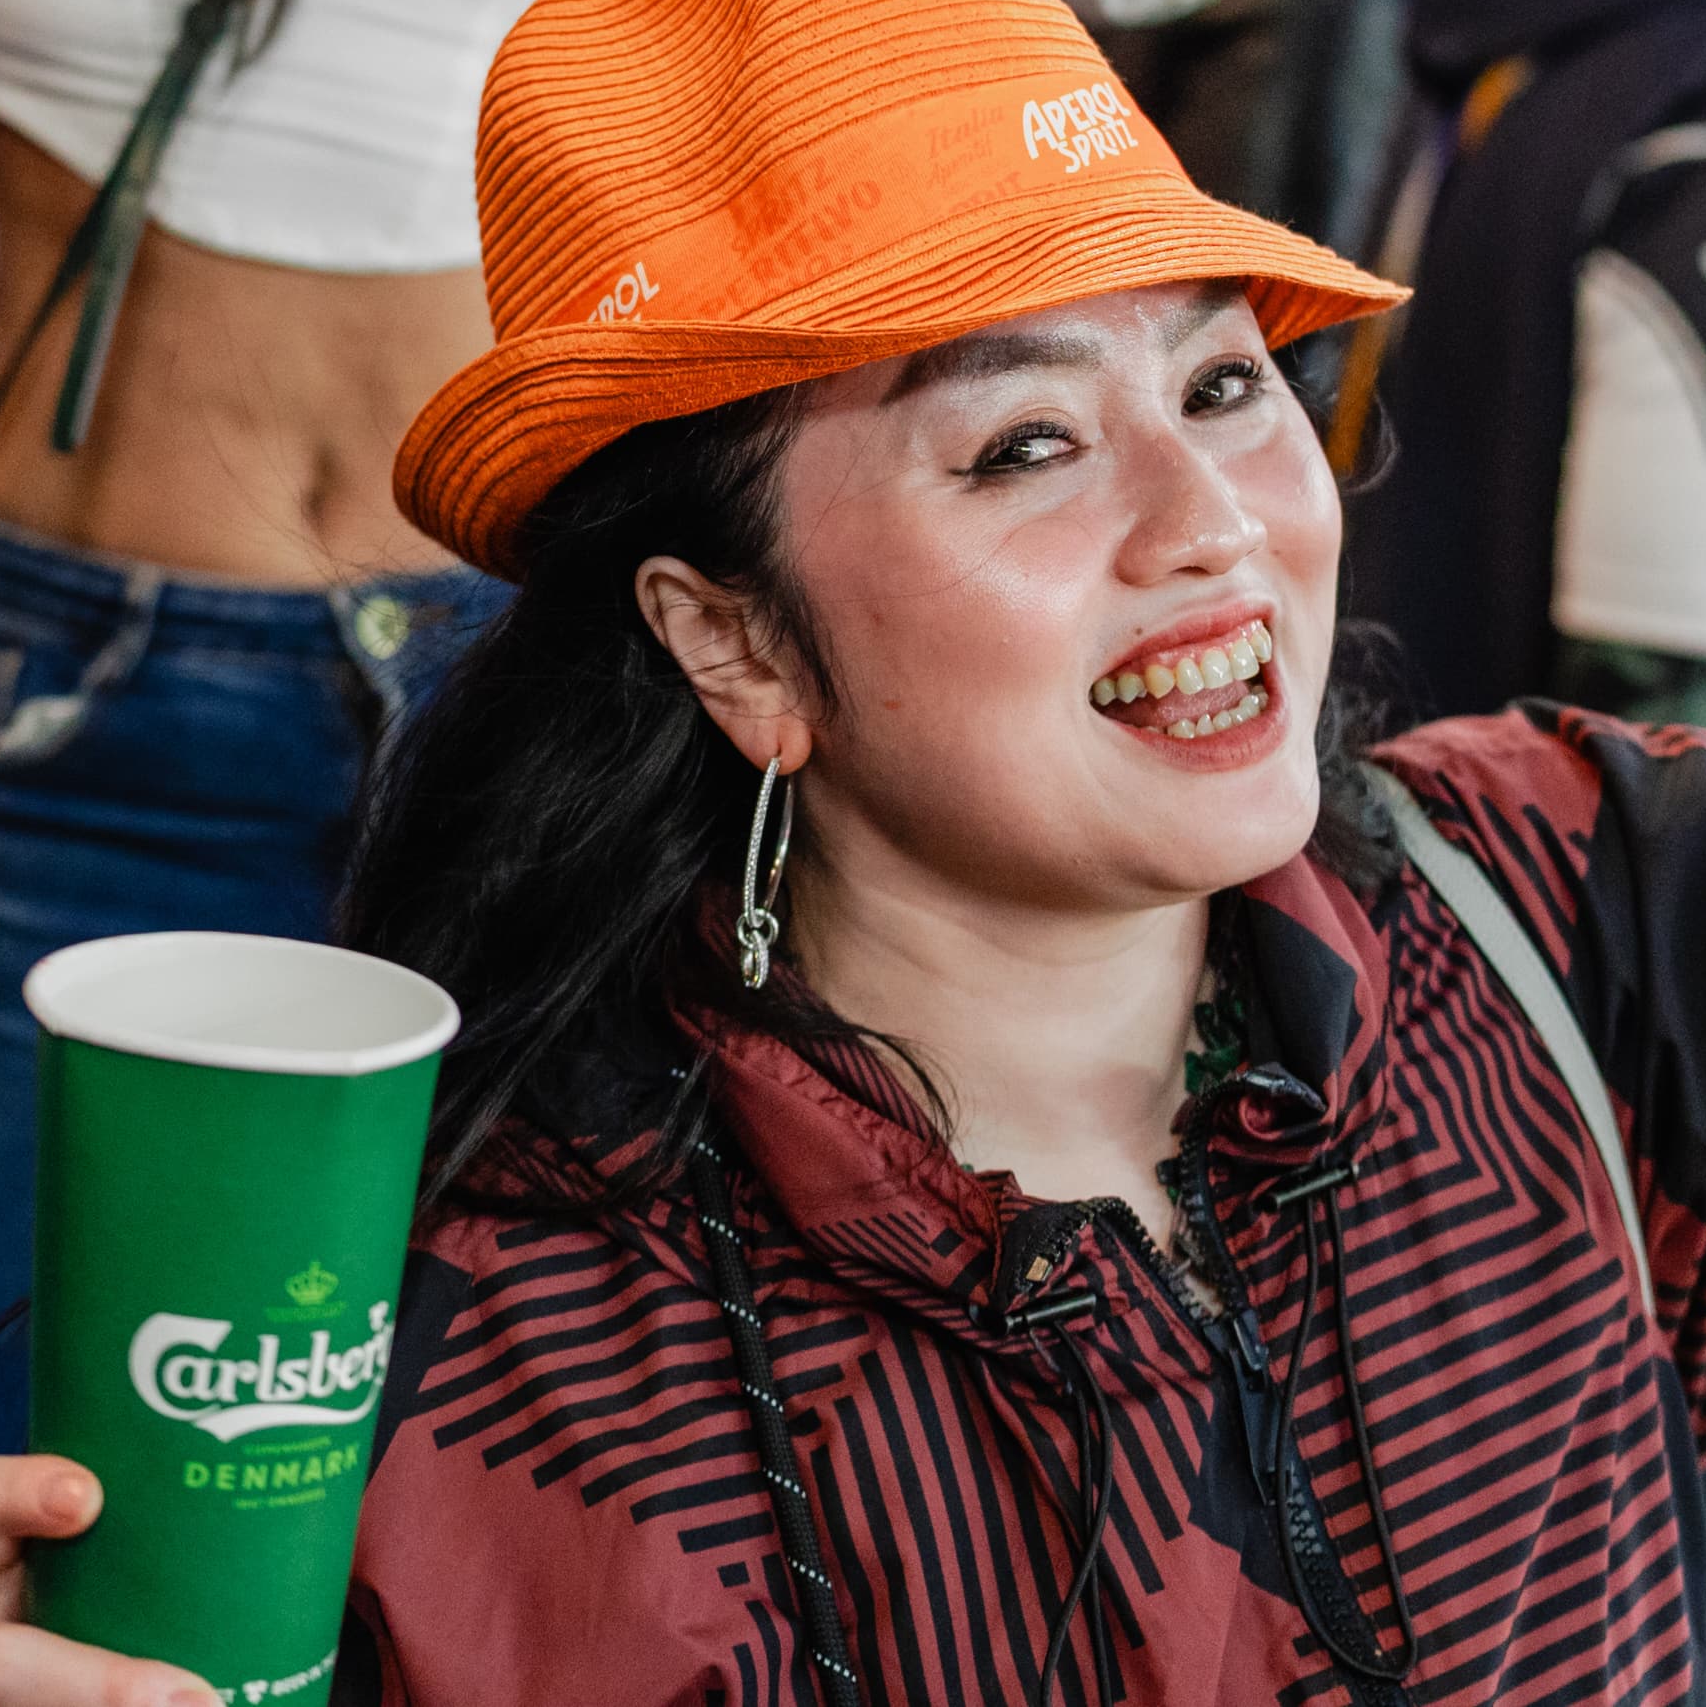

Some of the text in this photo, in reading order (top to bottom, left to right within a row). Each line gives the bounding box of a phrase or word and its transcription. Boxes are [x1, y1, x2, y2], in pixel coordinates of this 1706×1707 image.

[1022, 81, 1132, 160] APEROL
[1056, 119, 1139, 174] SPRITZ
[587, 261, 661, 326] ROL
[184, 1444, 360, 1491] DENMARK
